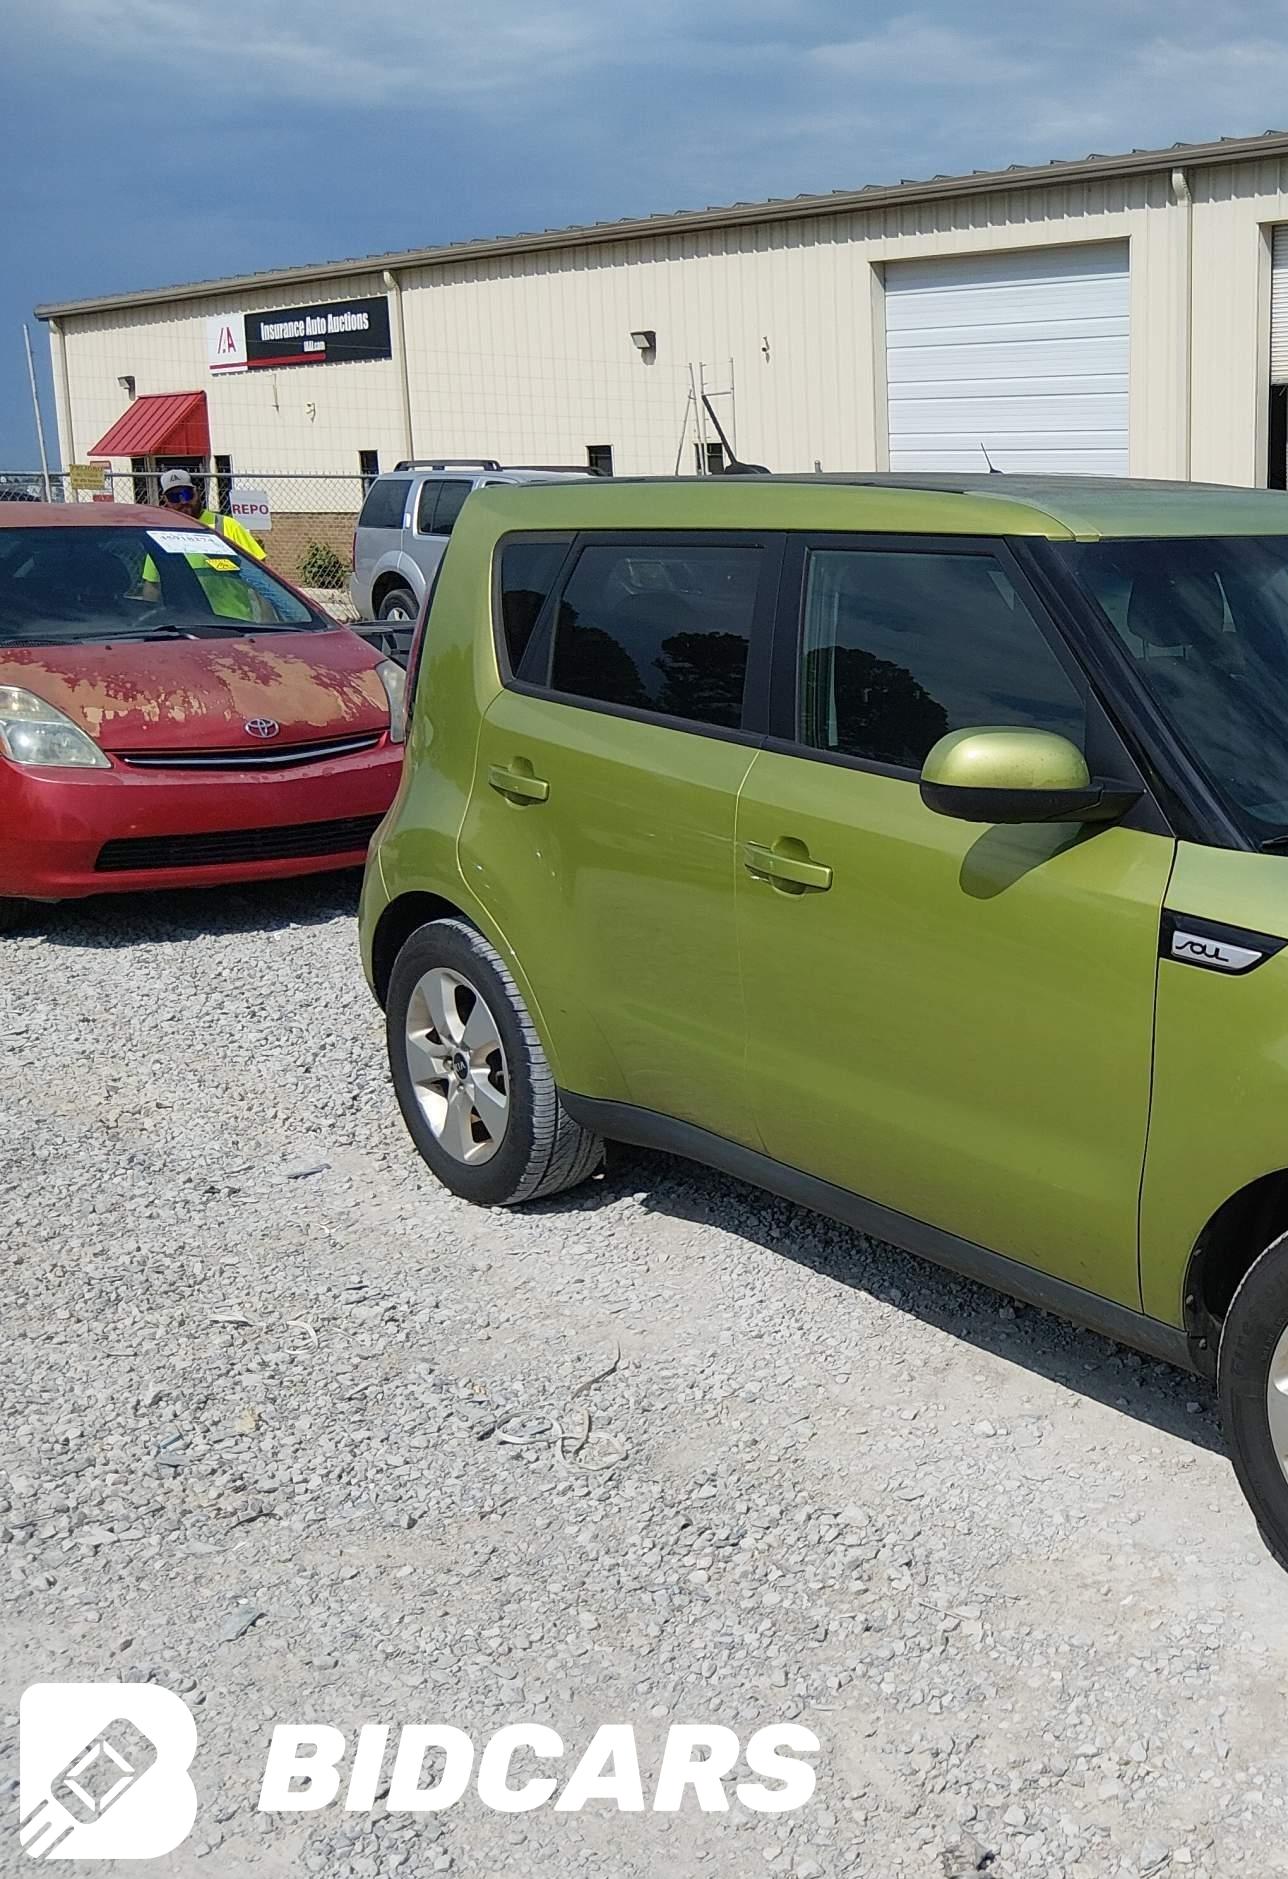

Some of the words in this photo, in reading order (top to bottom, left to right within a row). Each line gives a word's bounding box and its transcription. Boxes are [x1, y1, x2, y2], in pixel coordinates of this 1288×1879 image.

[260, 321, 305, 341] Insurance
[305, 316, 326, 336] Auto
[327, 312, 369, 333] Auctions
[232, 504, 269, 515] REPO
